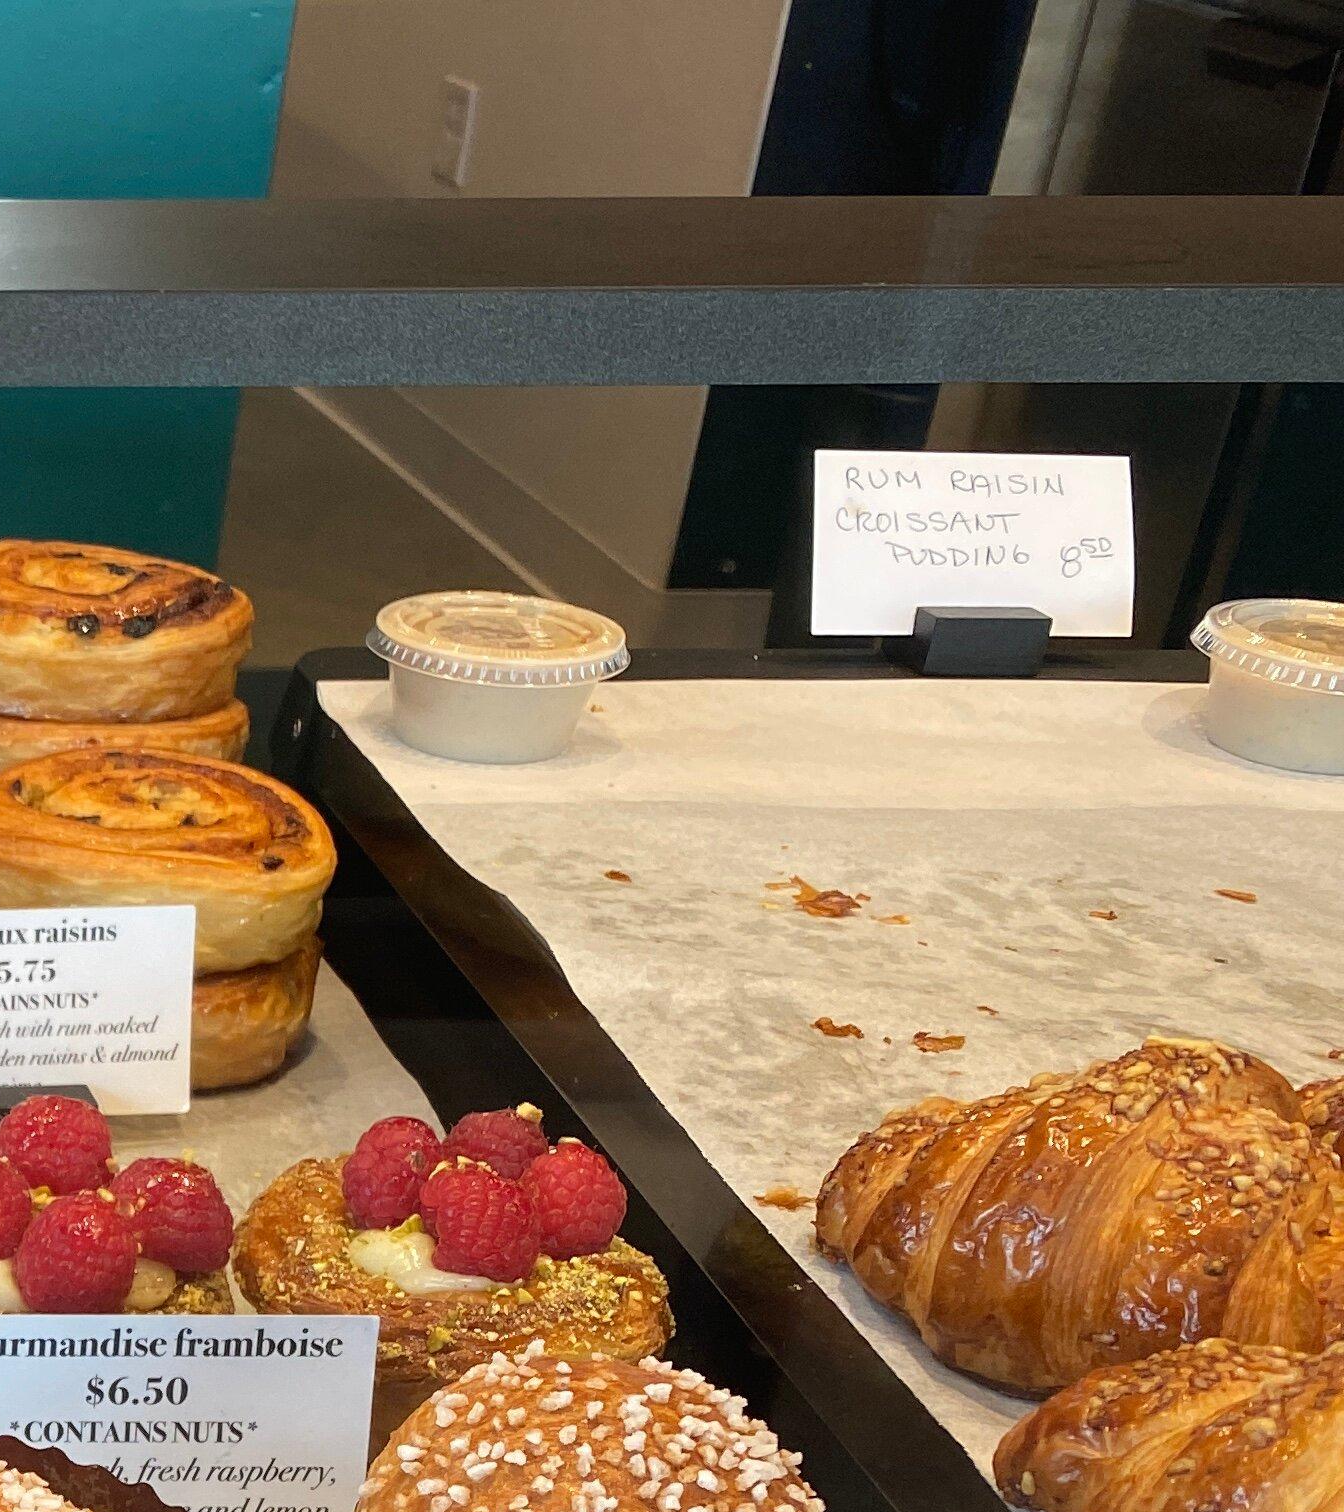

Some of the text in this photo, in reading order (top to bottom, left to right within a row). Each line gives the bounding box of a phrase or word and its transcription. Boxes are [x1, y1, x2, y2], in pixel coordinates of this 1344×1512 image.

[845, 466, 1064, 498] RUM RAISIN
[836, 507, 1021, 534] CROISSANT
[885, 541, 1030, 567] PUDDING
[34, 918, 117, 944] raisins
[16, 1019, 54, 1039] with
[56, 1023, 92, 1037] rum
[95, 1015, 157, 1036] soaked
[29, 1049, 86, 1066] raisins
[89, 1047, 108, 1064] &
[110, 1044, 178, 1063] almond
[172, 1327, 344, 1358] framboise
[85, 1374, 189, 1407] $6.50
[136, 1457, 200, 1484] fresh
[205, 1460, 336, 1490] raspberry,
